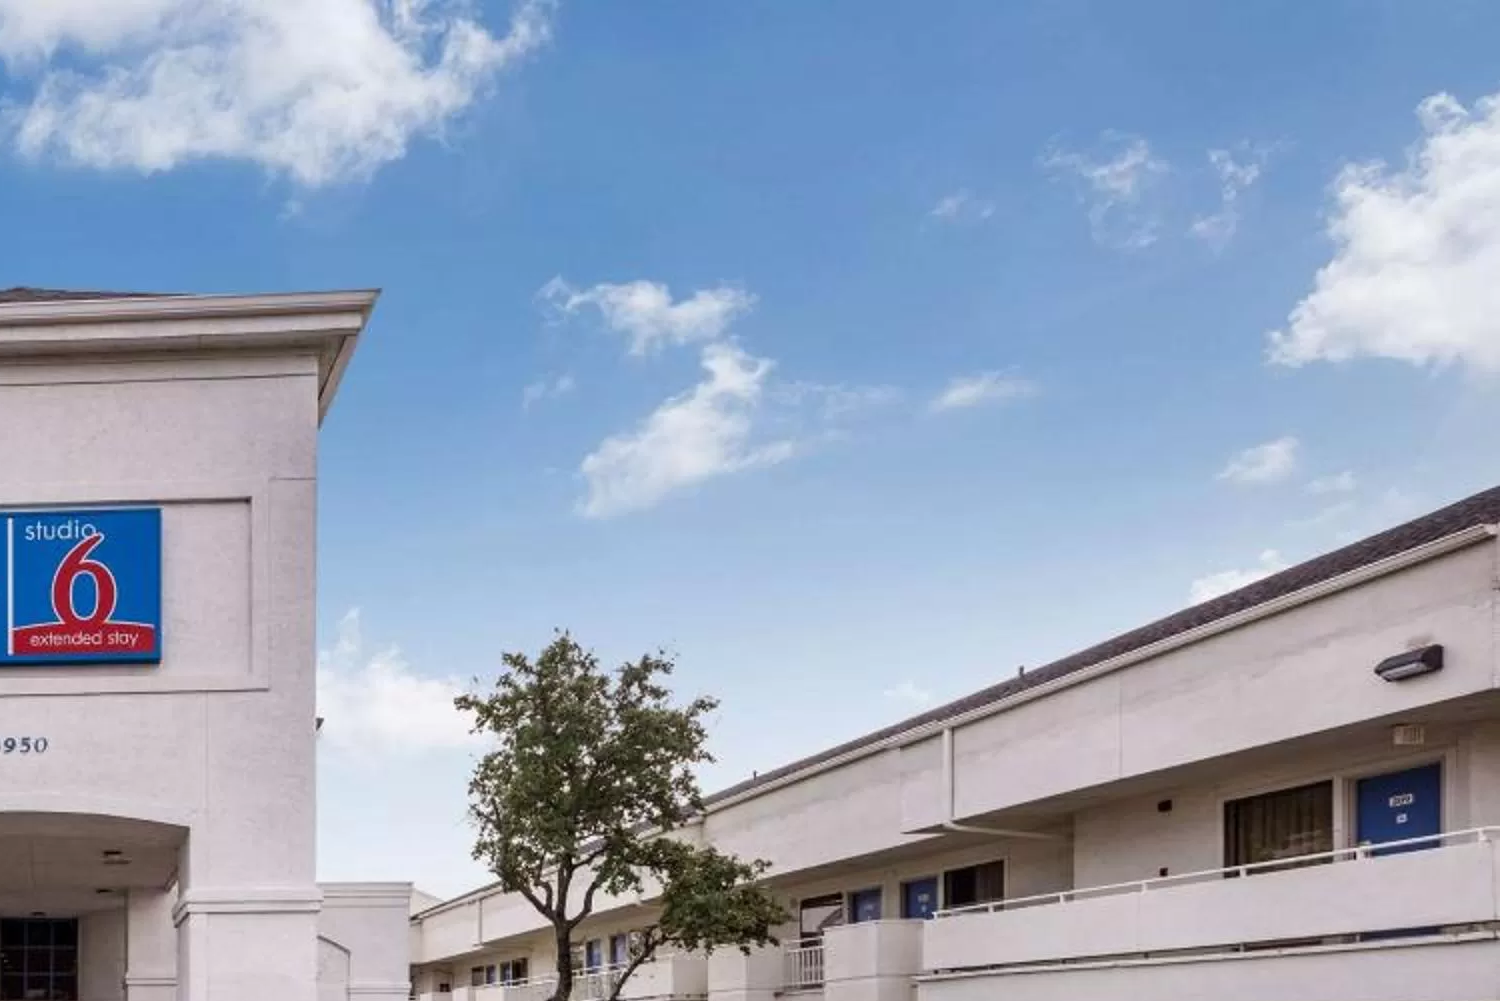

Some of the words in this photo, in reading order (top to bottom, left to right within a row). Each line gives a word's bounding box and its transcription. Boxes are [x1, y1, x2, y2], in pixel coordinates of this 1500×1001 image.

[25, 519, 97, 541] studio
[51, 531, 117, 624] 6
[30, 630, 102, 647] extended
[107, 631, 139, 648] stay
